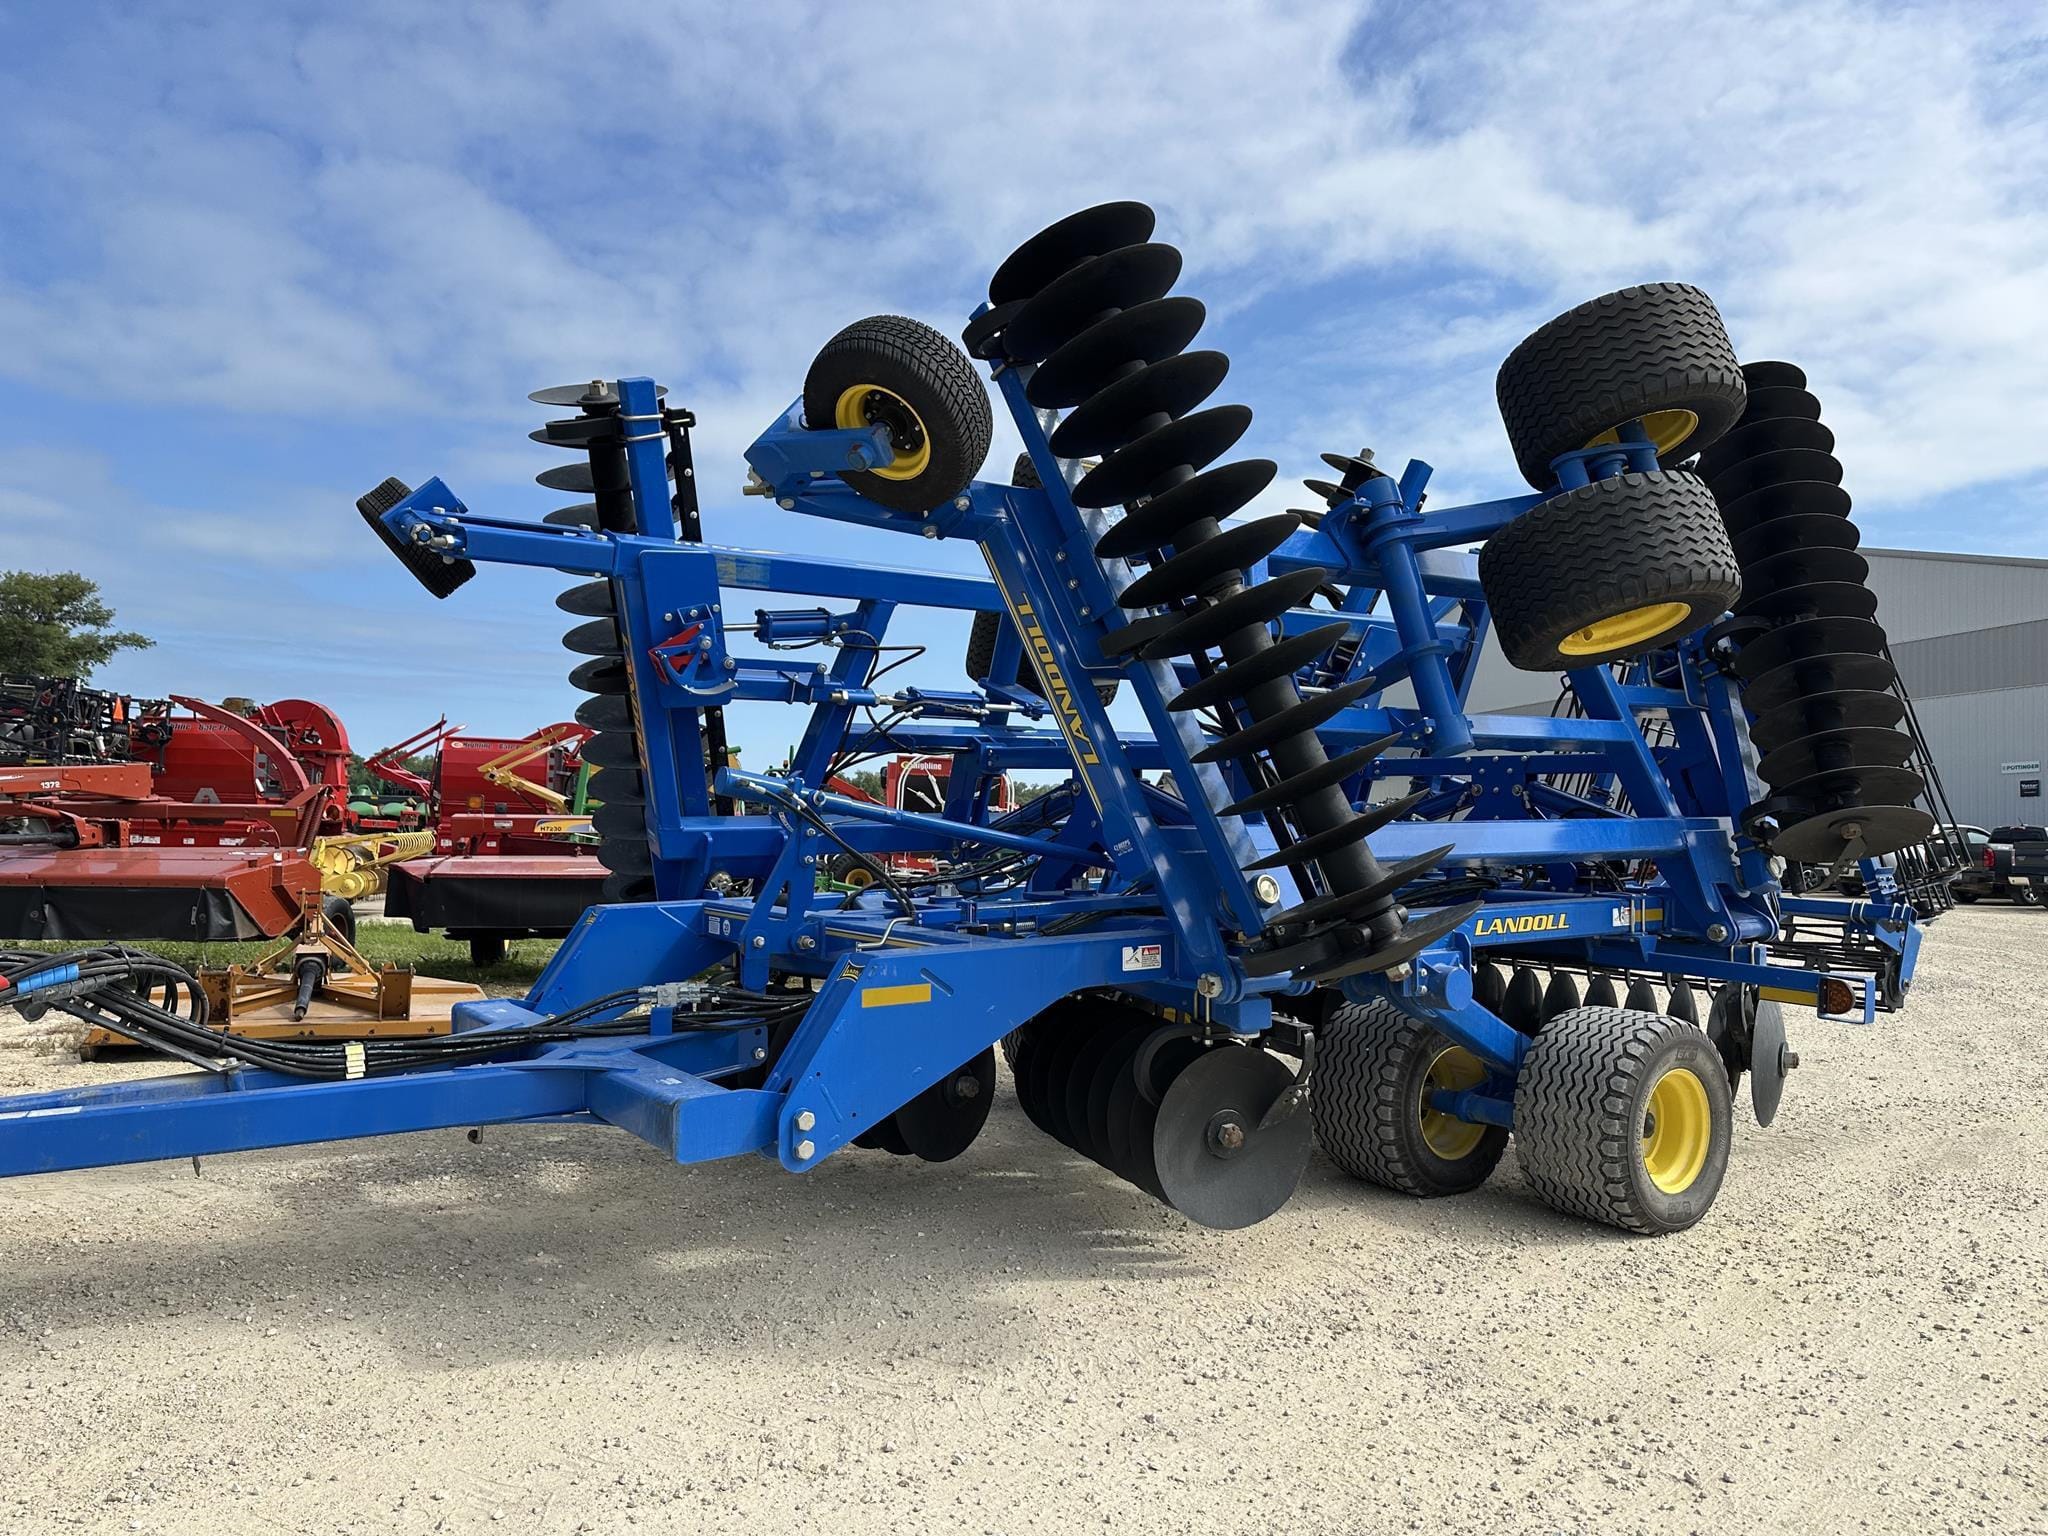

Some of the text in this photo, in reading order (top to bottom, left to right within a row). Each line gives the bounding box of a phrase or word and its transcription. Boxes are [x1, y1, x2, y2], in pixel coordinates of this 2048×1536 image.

[1017, 592, 1100, 764] LANDOLL
[40, 781, 61, 789] 1372
[1474, 913, 1570, 936] LANDOLL
